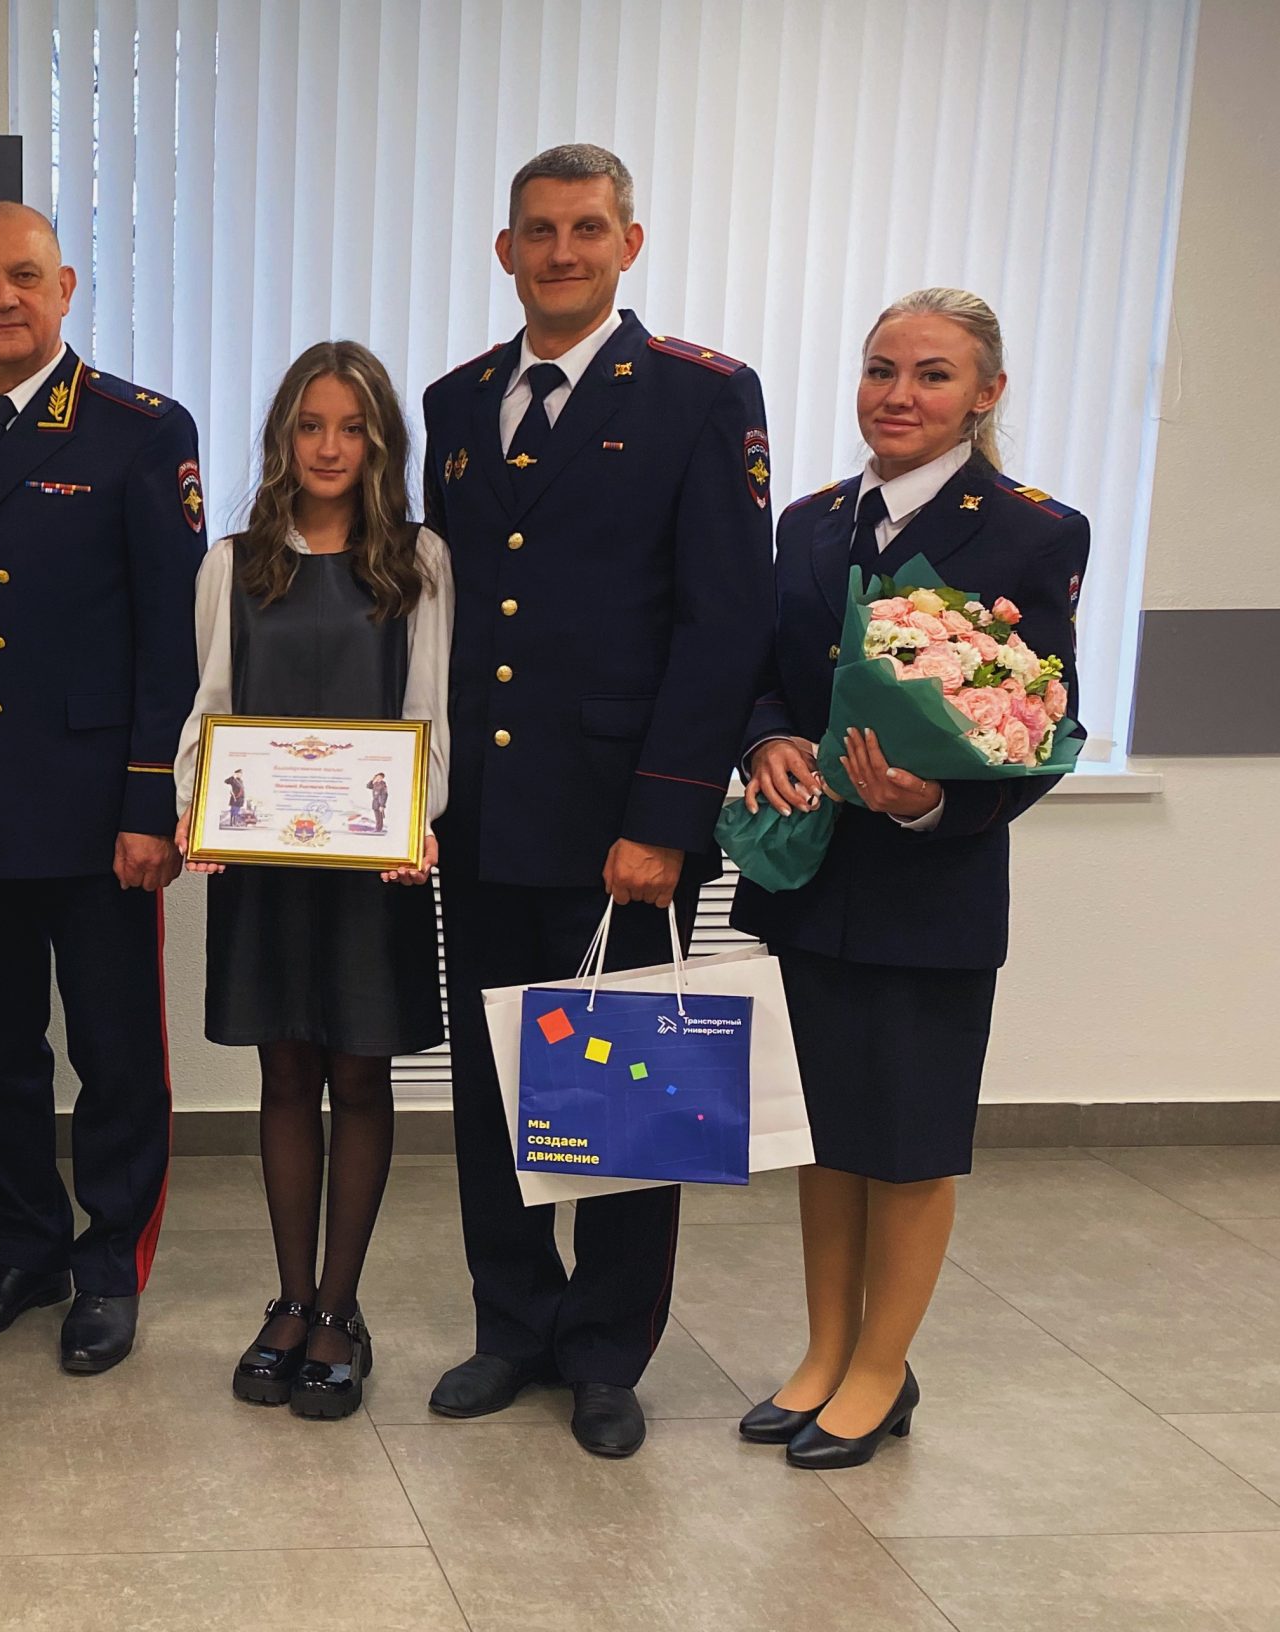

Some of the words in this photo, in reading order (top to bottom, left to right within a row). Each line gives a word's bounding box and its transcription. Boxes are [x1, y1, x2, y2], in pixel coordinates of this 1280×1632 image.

[683, 1016, 742, 1027] Транспортный
[683, 1027, 735, 1036] университет
[528, 1119, 551, 1130] мы
[527, 1135, 588, 1148] создаем
[526, 1151, 600, 1165] движение
